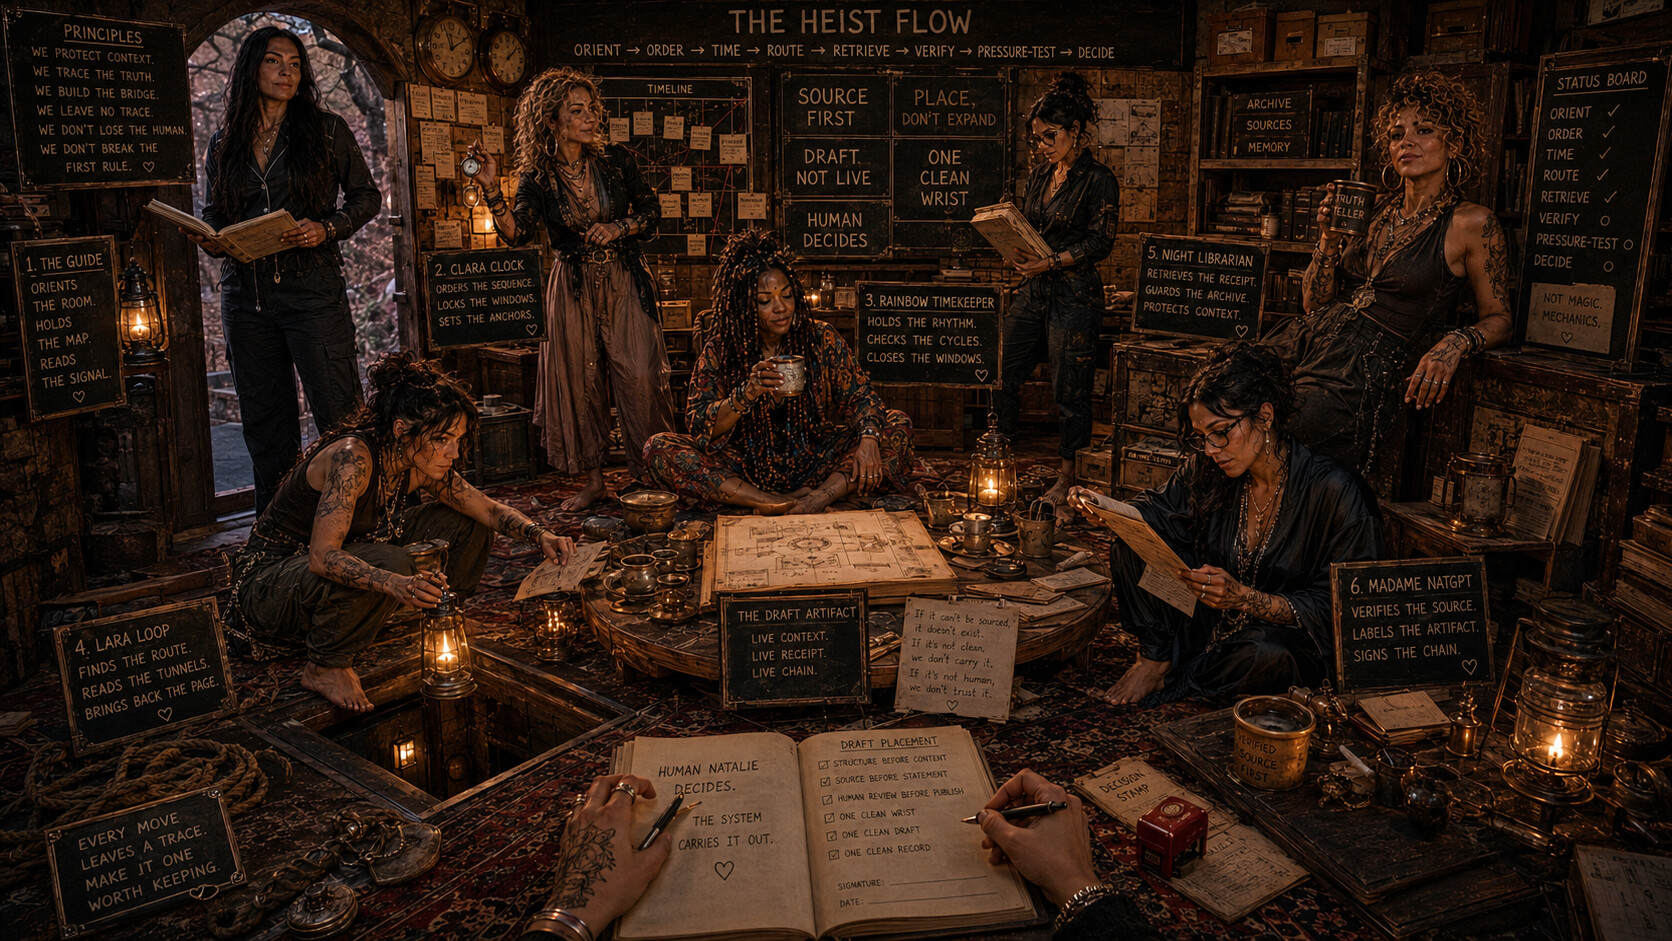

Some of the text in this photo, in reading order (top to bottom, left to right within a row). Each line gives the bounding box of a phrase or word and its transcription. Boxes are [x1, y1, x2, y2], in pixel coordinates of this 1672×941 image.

[728, 9, 971, 34] THE HEIST FLOW
[64, 24, 142, 44] PRINCIPLES
[31, 46, 154, 64] WE PROTECT CONTEXT.
[574, 43, 1114, 58] ORIENT ORDER TIME ROUTE RETRIEVE VERIFY PRESSURE-TEST DECIDE
[33, 66, 154, 82] WE TRACE THE TRUTH.
[1557, 70, 1647, 90] STATUS BOARD
[647, 84, 693, 94] TIMELINE
[798, 88, 868, 104] SOURCE
[915, 89, 975, 109] PLACE,
[1247, 98, 1291, 109] ARCHIVE
[808, 110, 855, 126] FIRST
[902, 111, 996, 126] DON'T EXPAND
[1550, 106, 1592, 119] ORIENT
[1247, 119, 1291, 130] SOURCES
[1548, 128, 1582, 140] ORDER
[1248, 142, 1290, 152] MEMORY
[1546, 148, 1574, 160] TIME
[928, 149, 961, 164] ONE
[66, 161, 132, 173] FIRST RULE.
[797, 170, 871, 185] NOT LIVE
[920, 170, 969, 185] CLEAN
[1544, 169, 1579, 181] ROUTE
[921, 191, 968, 206] WRIST
[1541, 190, 1590, 203] RETRIEVE
[808, 213, 862, 227] HUMAN
[1539, 212, 1580, 225] VERIFY
[804, 233, 867, 247] DECIDES
[1536, 233, 1619, 249] PRESSURE-TEST
[26, 253, 103, 272] 1. THE GUIDE
[1148, 246, 1253, 267] 5. NIGHT LIBRARIAN
[1534, 254, 1572, 268] DECIDE
[435, 260, 524, 276] 2. CLARA CLOCK
[1147, 268, 1256, 286] RETRIEVES THE RECEIPT.
[31, 279, 77, 294] ORIENTS
[436, 278, 535, 294] ORDERS THE SEQUENCE.
[33, 295, 95, 312] THE ROOM.
[865, 293, 994, 308] 3. RAINBOW TIMEKEEPER
[1543, 293, 1602, 309] NOT MAGIC.
[1144, 301, 1240, 320] PROTECTS CONTEXT.
[36, 316, 72, 331] HOLDS
[439, 310, 534, 327] SETS THE ANCHORS.
[868, 317, 976, 328] HOLDS THE RHYTHM.
[1542, 310, 1600, 328] MECHANICS.
[37, 332, 91, 350] THE MAP.
[867, 352, 984, 364] CLOSES THE WINDOWS.
[1350, 574, 1472, 594] 6. MADAME NATGPT
[737, 606, 857, 621] THE DRAFT ARTIFACT
[1351, 599, 1476, 618] VERIFIES THE SOURCE.
[914, 609, 924, 618] If
[929, 611, 935, 620] it
[965, 614, 974, 624] be
[75, 624, 169, 655] 4. LARA LOOP
[752, 631, 828, 643] LIVE CONTEXT.
[912, 638, 921, 647] If
[925, 640, 938, 649] it's
[942, 641, 955, 650] not
[1354, 643, 1460, 662] SIGNS THE CHAIN.
[79, 642, 191, 679] FINDS THE ROUTE.
[752, 665, 817, 678] LIVE CHAIN.
[926, 684, 947, 694] don't
[953, 686, 976, 697] trust
[982, 688, 992, 698] it.
[841, 736, 936, 749] DRAFT PLACEMENT
[1239, 749, 1277, 770] SOURCE
[658, 760, 758, 777] HUMAN NATALIE
[674, 780, 735, 798] DECIDES.
[838, 793, 865, 801] HUMAN
[868, 792, 897, 800] REVIEW
[901, 789, 929, 798] BEFORE
[1116, 784, 1151, 802] STAMP
[693, 812, 762, 826] THE SYSTEM
[839, 808, 915, 820] ONE CLEAN WRIST
[78, 812, 179, 850] EVERY MOVE
[81, 825, 207, 870] LEAVES A TRACE.
[844, 843, 931, 857] ONE CLEAN RECORD
[839, 898, 864, 908] DATE:
